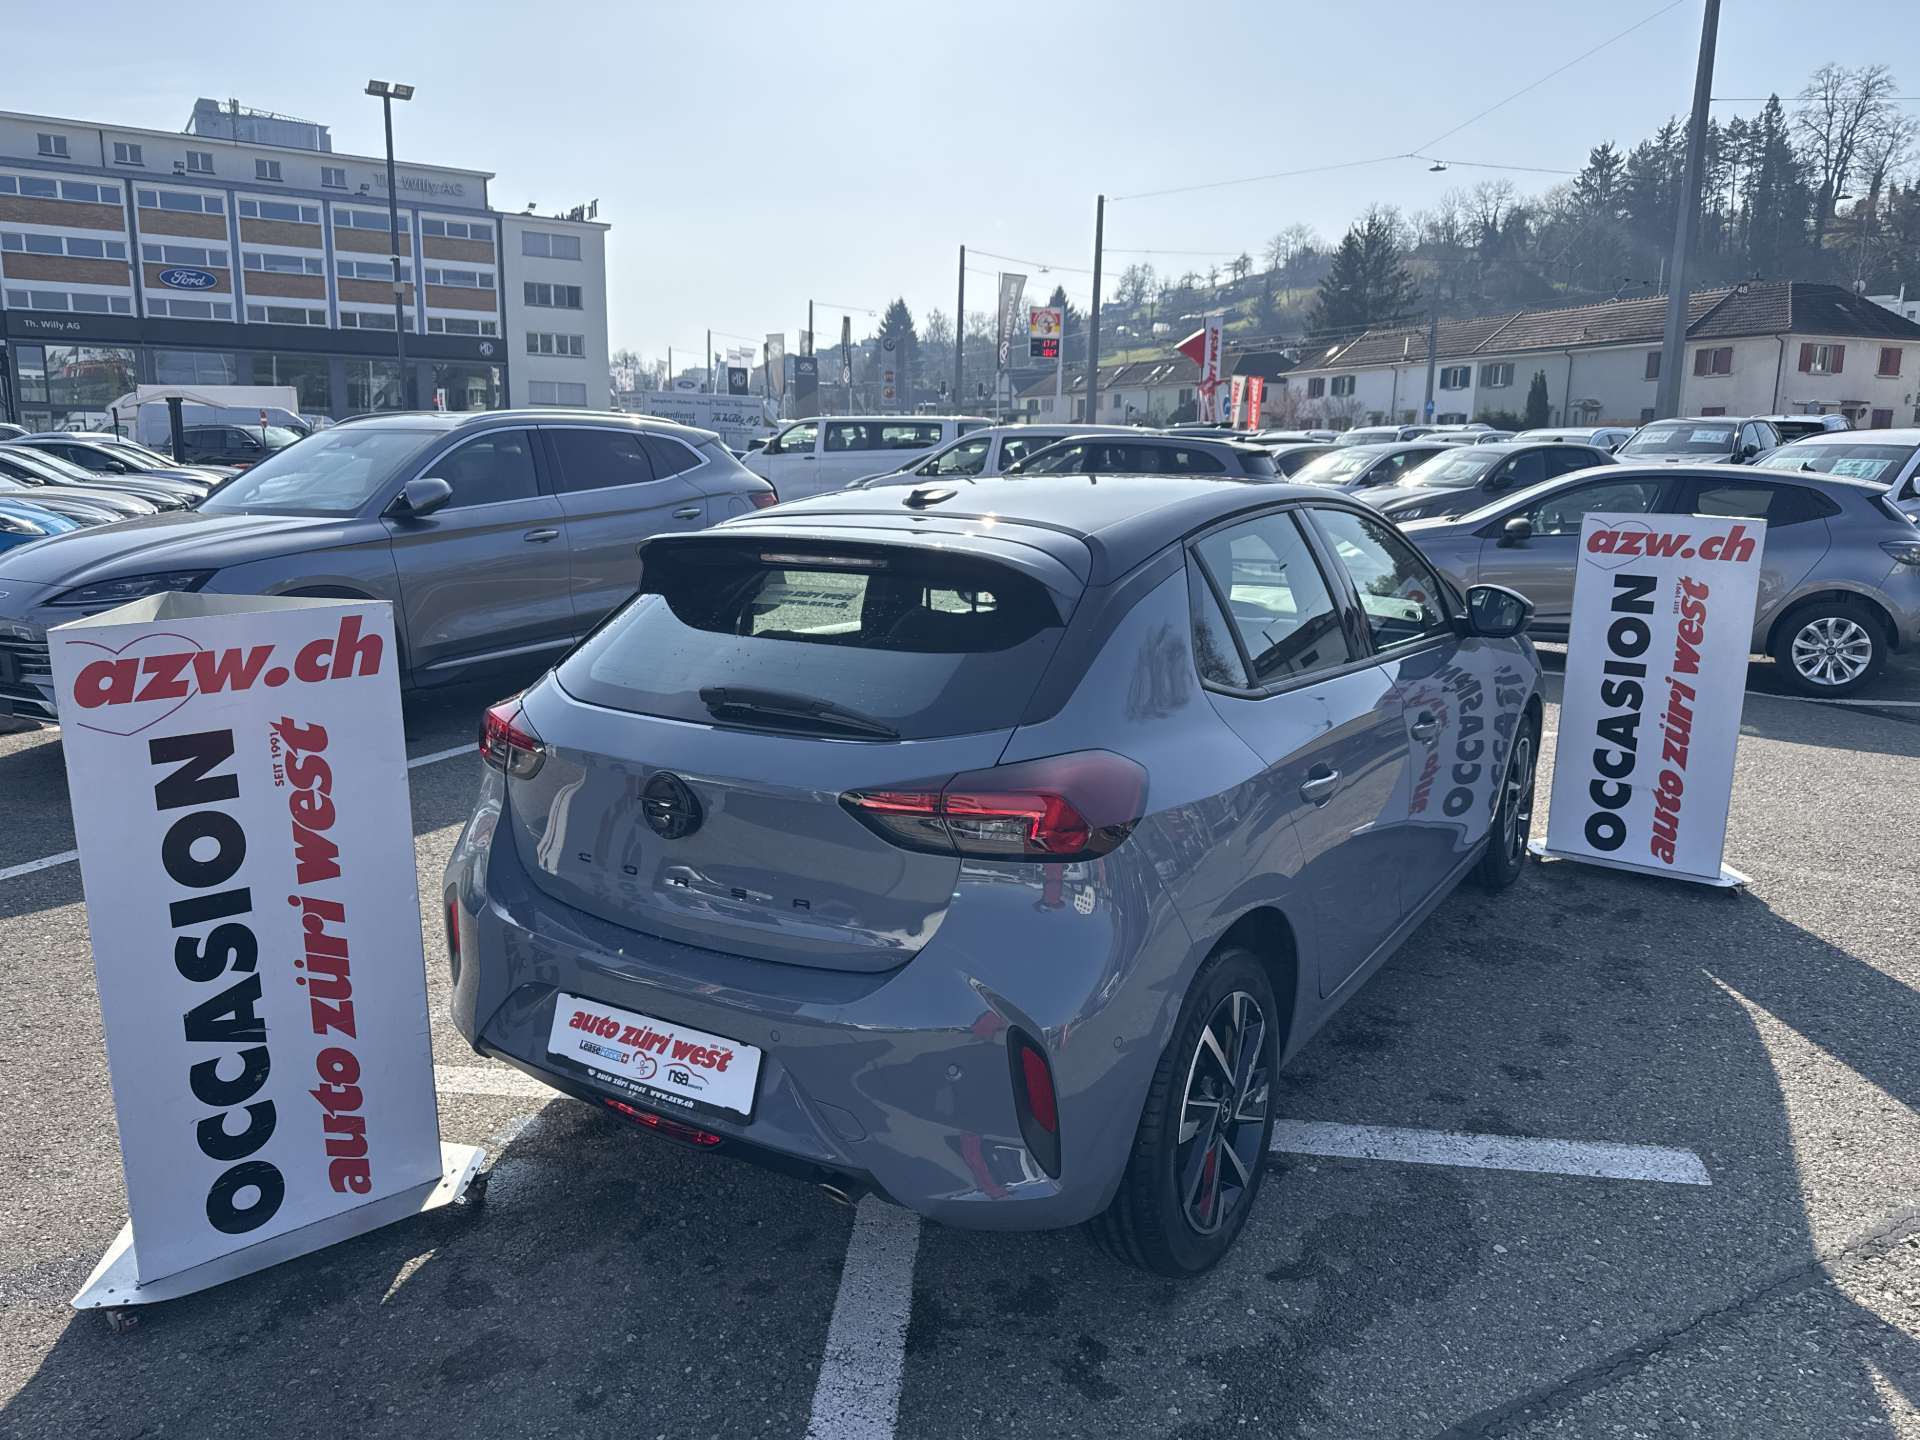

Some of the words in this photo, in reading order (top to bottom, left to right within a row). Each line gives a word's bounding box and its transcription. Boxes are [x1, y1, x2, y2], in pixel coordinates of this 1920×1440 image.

[401, 175, 441, 197] Willy
[441, 183, 465, 197] AG
[171, 269, 206, 287] Ford
[24, 319, 39, 329] Th.
[41, 320, 64, 331] Willy
[67, 321, 81, 331] AG
[1587, 526, 1756, 561] azw.ch
[1673, 598, 1681, 614] SEIT
[1673, 576, 1710, 674] west
[73, 615, 384, 709] azw.ch
[1584, 574, 1658, 851] OCCASION
[1660, 676, 1697, 771] züri
[270, 730, 281, 760] 1991
[270, 716, 341, 885] west
[273, 764, 284, 788] SEIT
[1651, 769, 1684, 864] auto
[578, 851, 811, 910] CORSA
[148, 729, 285, 1235] OCCASION
[287, 895, 356, 1039] züri
[569, 1011, 620, 1039] auto
[618, 1025, 674, 1055] züri
[671, 1040, 734, 1072] west
[596, 1071, 613, 1083] auto
[628, 1081, 647, 1095] west
[649, 1088, 695, 1109] www.azw.ch
[668, 1069, 690, 1086] nsa
[308, 1047, 372, 1194] auto
